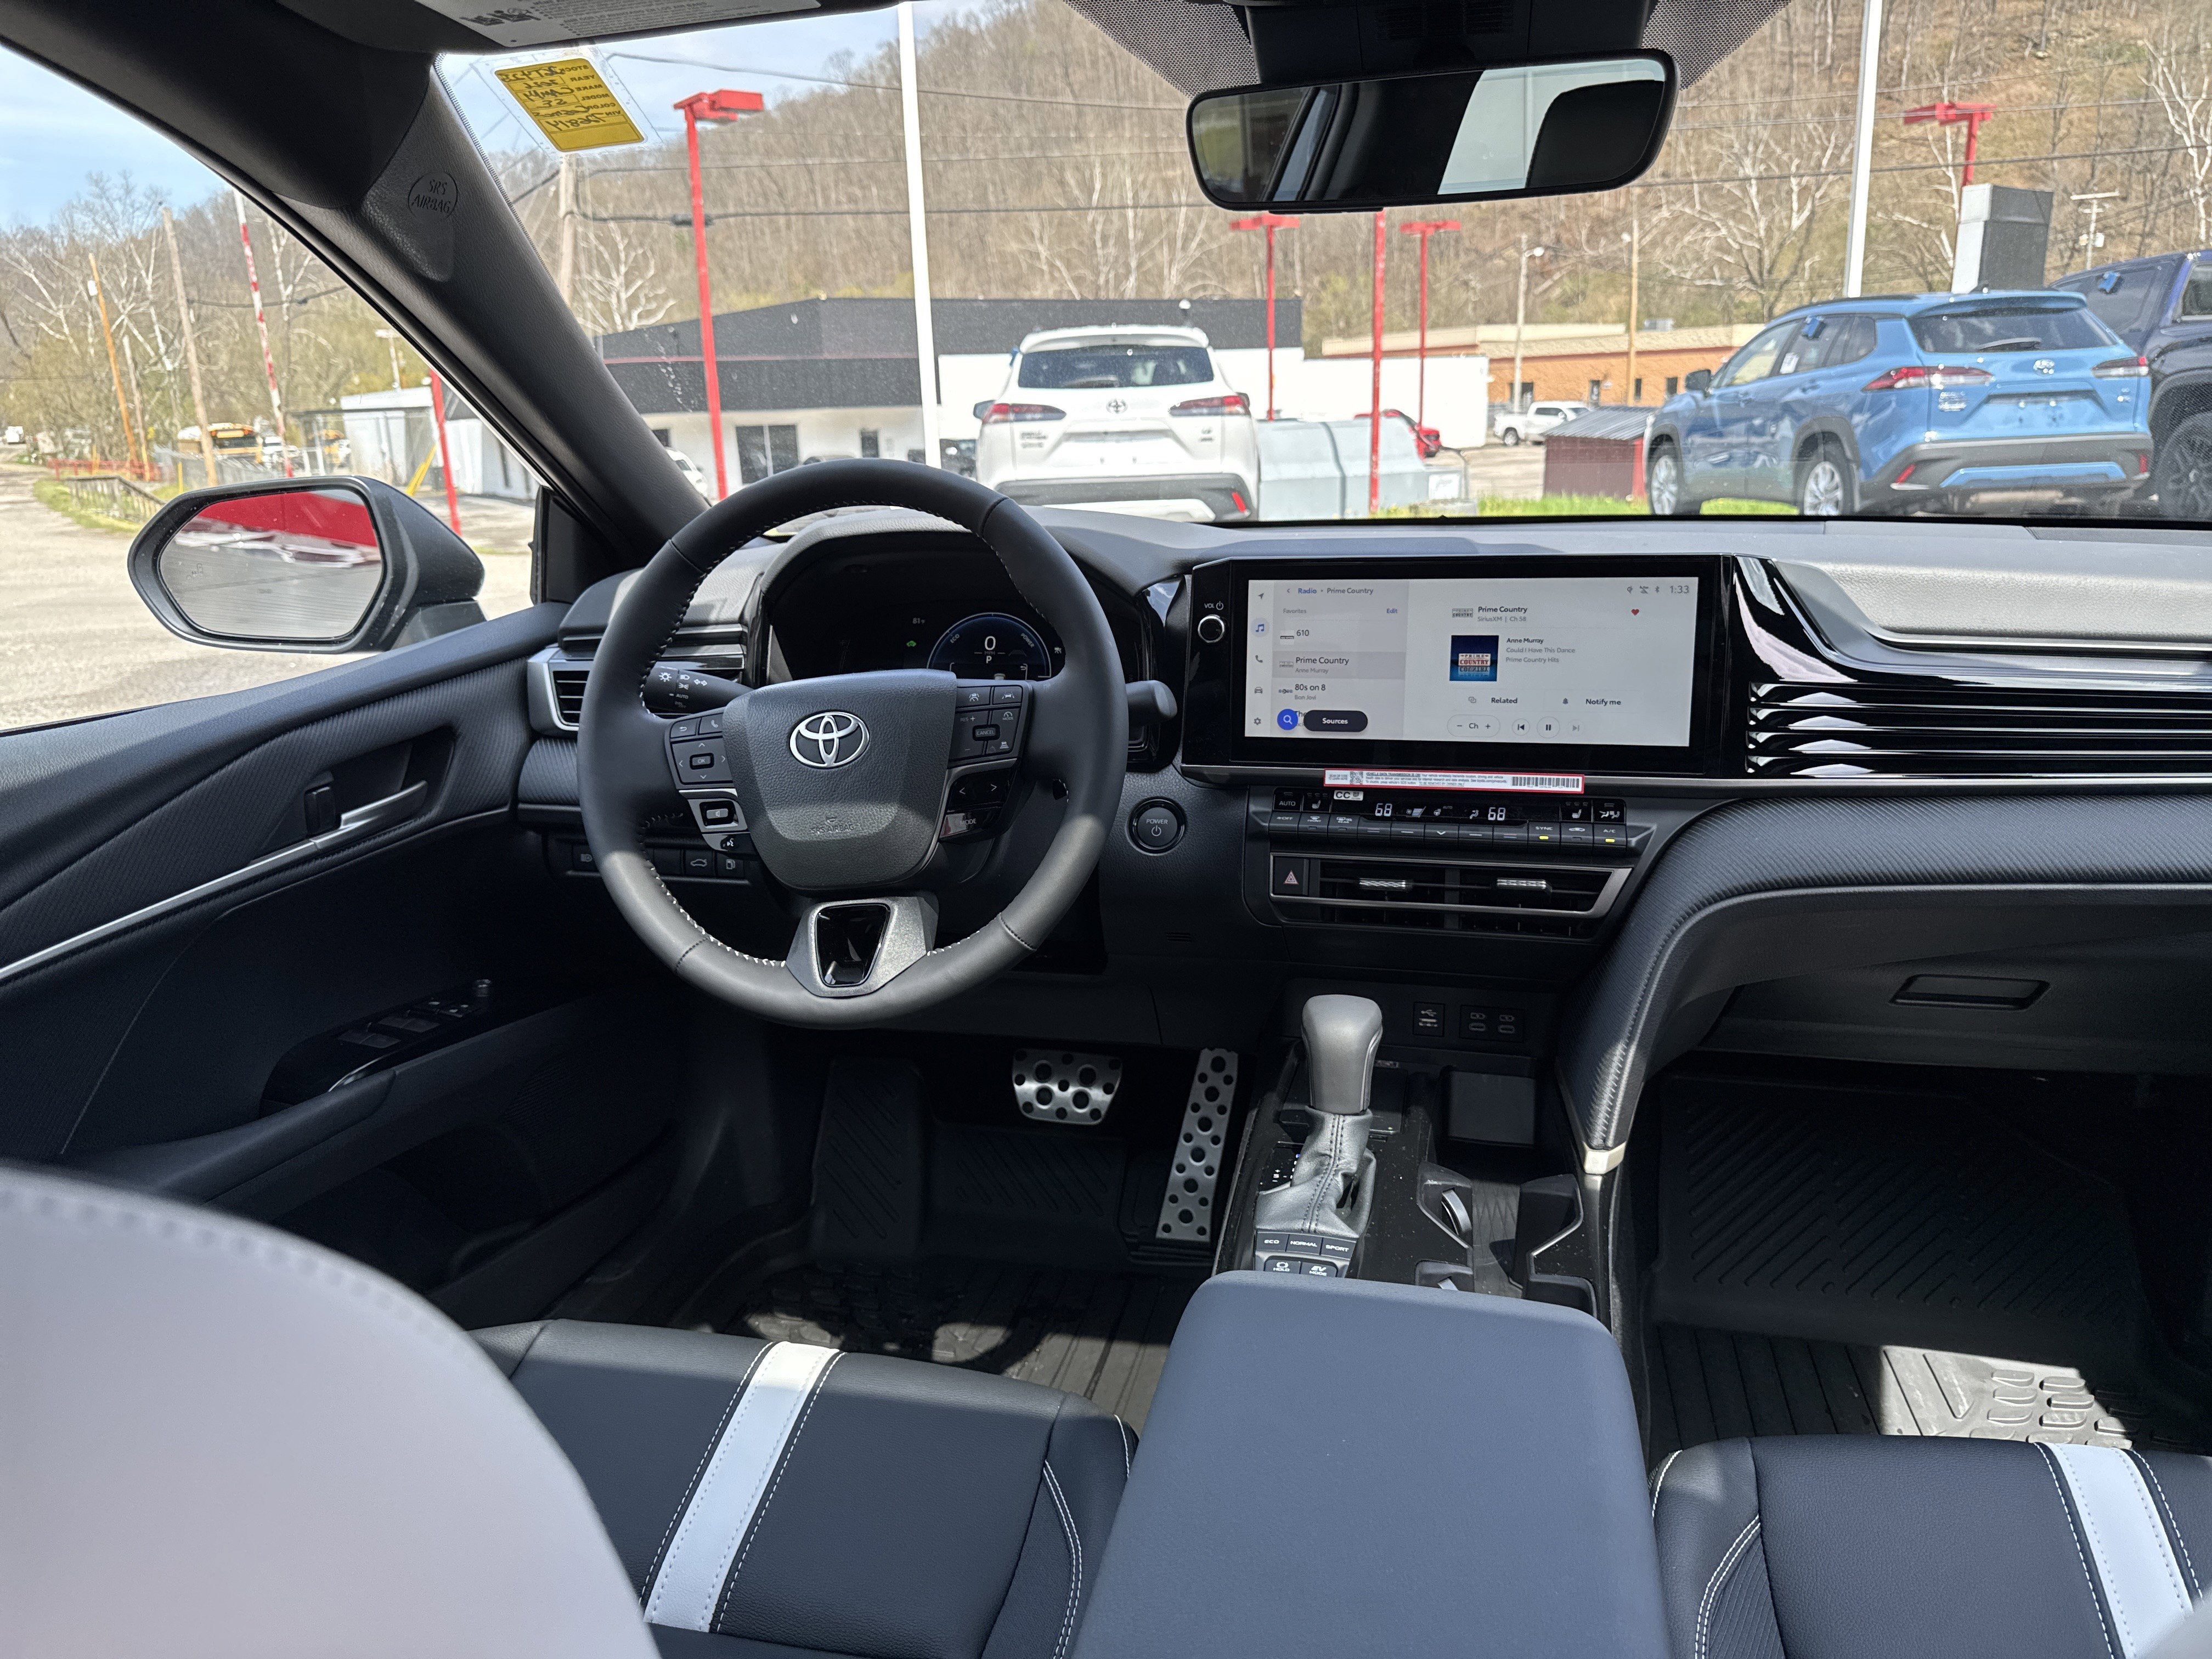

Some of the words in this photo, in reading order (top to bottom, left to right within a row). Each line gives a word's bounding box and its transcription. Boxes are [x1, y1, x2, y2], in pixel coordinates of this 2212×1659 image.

[428, 179, 448, 195] SRS
[411, 193, 453, 213] AIRBAG
[1669, 585, 1690, 594] 1:33
[1499, 606, 1528, 614] Country
[950, 634, 960, 644] ECO
[984, 636, 996, 650] 0
[1020, 633, 1035, 648] POWER
[986, 656, 992, 664] P
[1319, 657, 1350, 665] Country
[1585, 698, 1608, 707] Notify
[1375, 803, 1392, 817] 68
[1487, 807, 1506, 821] 68
[811, 827, 825, 835] SRS
[827, 823, 854, 833] AIRBAG
[1325, 1244, 1350, 1252] SPORT
